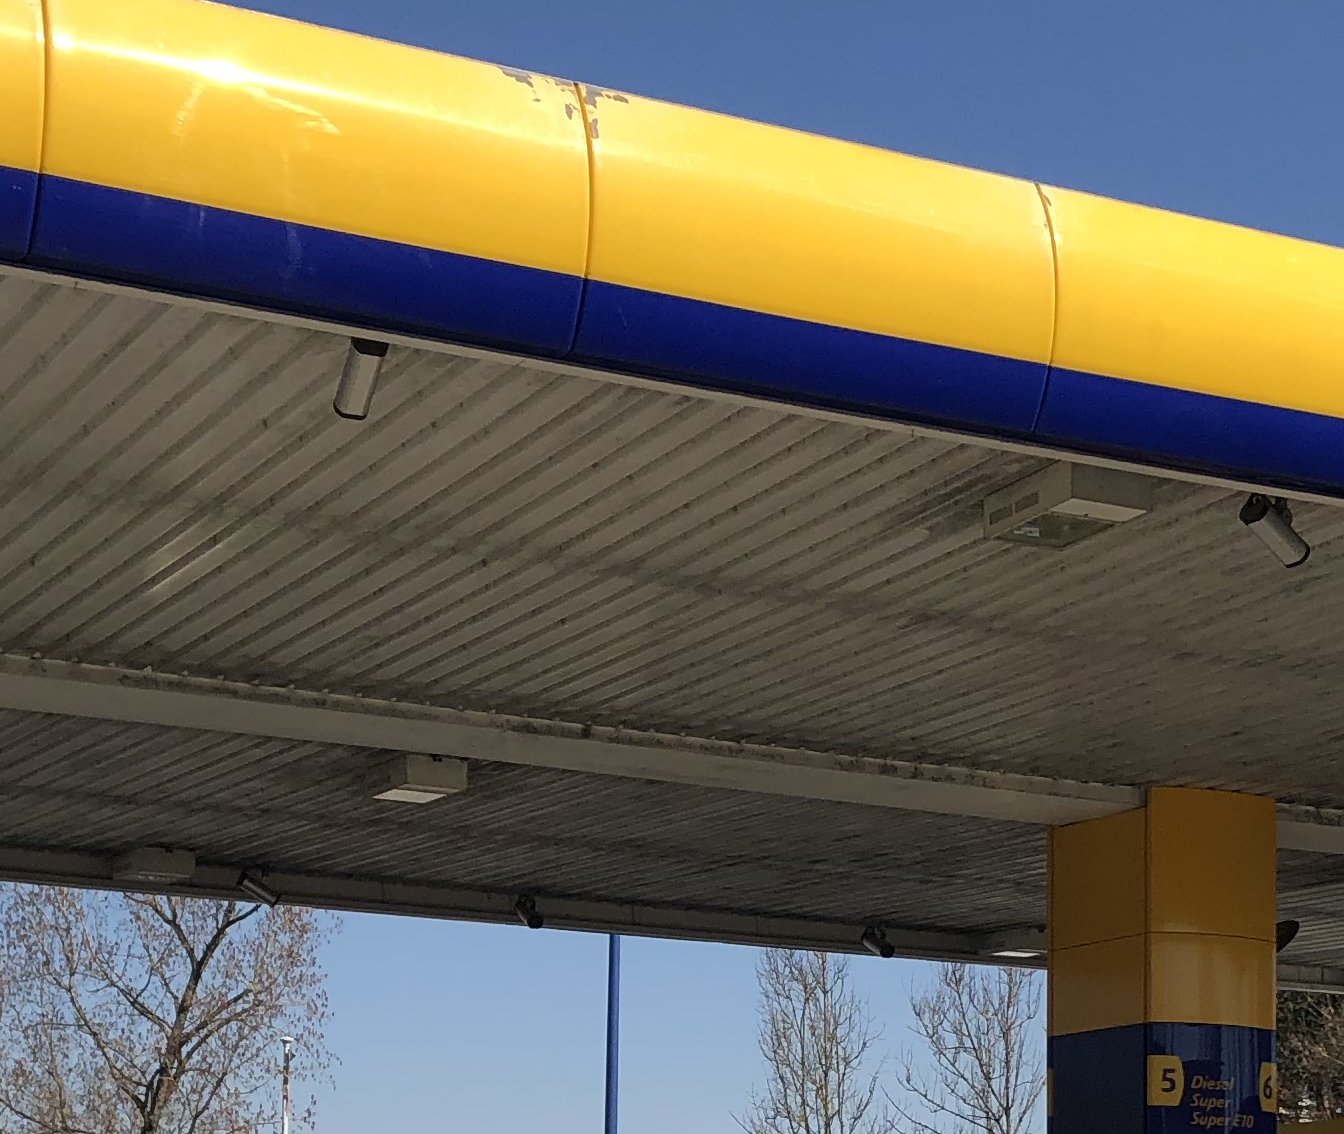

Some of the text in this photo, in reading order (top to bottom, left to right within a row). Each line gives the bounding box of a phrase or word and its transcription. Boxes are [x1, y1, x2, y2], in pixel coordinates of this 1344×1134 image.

[1161, 1069, 1176, 1092] 5
[1191, 1075, 1235, 1091] Diesel
[1190, 1093, 1232, 1112] Super
[1190, 1112, 1254, 1130] Super E10
